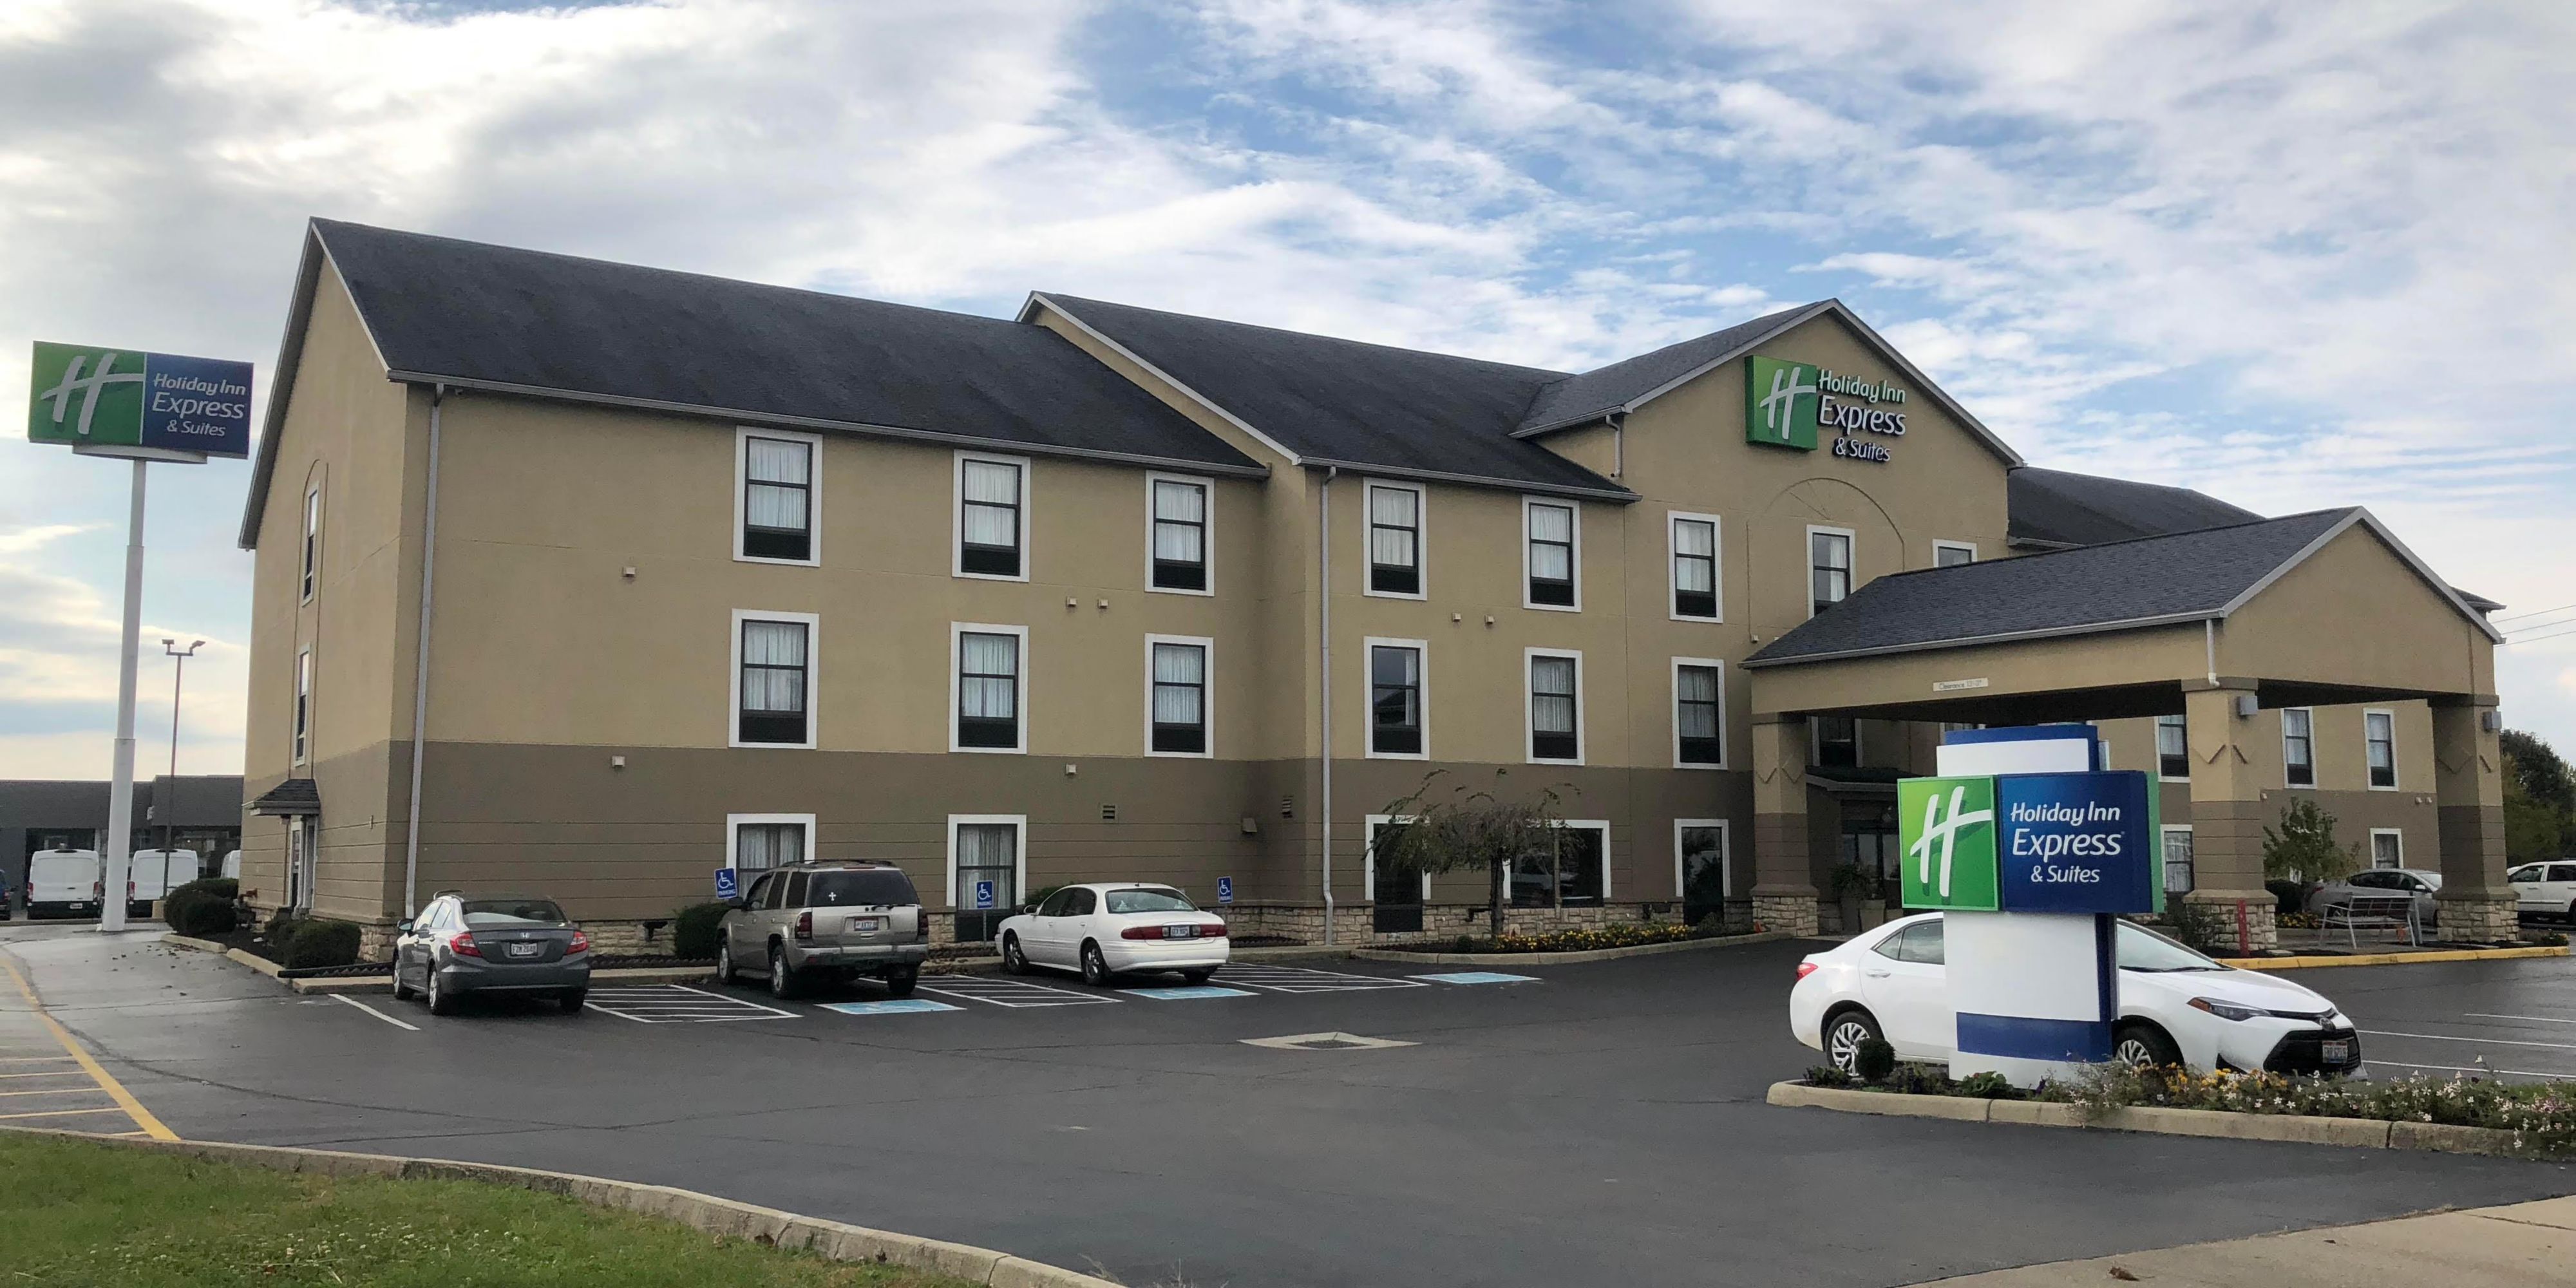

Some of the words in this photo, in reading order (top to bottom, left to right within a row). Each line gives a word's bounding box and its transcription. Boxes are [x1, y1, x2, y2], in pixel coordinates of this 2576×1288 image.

[153, 372, 218, 396] Holiday
[220, 378, 247, 396] Inn
[1819, 369, 1879, 403] Holiday
[1882, 379, 1906, 403] Inn
[151, 391, 245, 419] Express
[1819, 394, 1906, 435] Express
[167, 420, 177, 433] &
[181, 421, 226, 437] Suites
[1835, 437, 1846, 455] &
[1849, 439, 1891, 462] Suites
[2011, 802, 2084, 826] Holiday
[2087, 801, 2120, 821] Inn
[2012, 828, 2121, 863] Express
[2031, 866, 2043, 882] &
[2047, 865, 2100, 883] Suites
